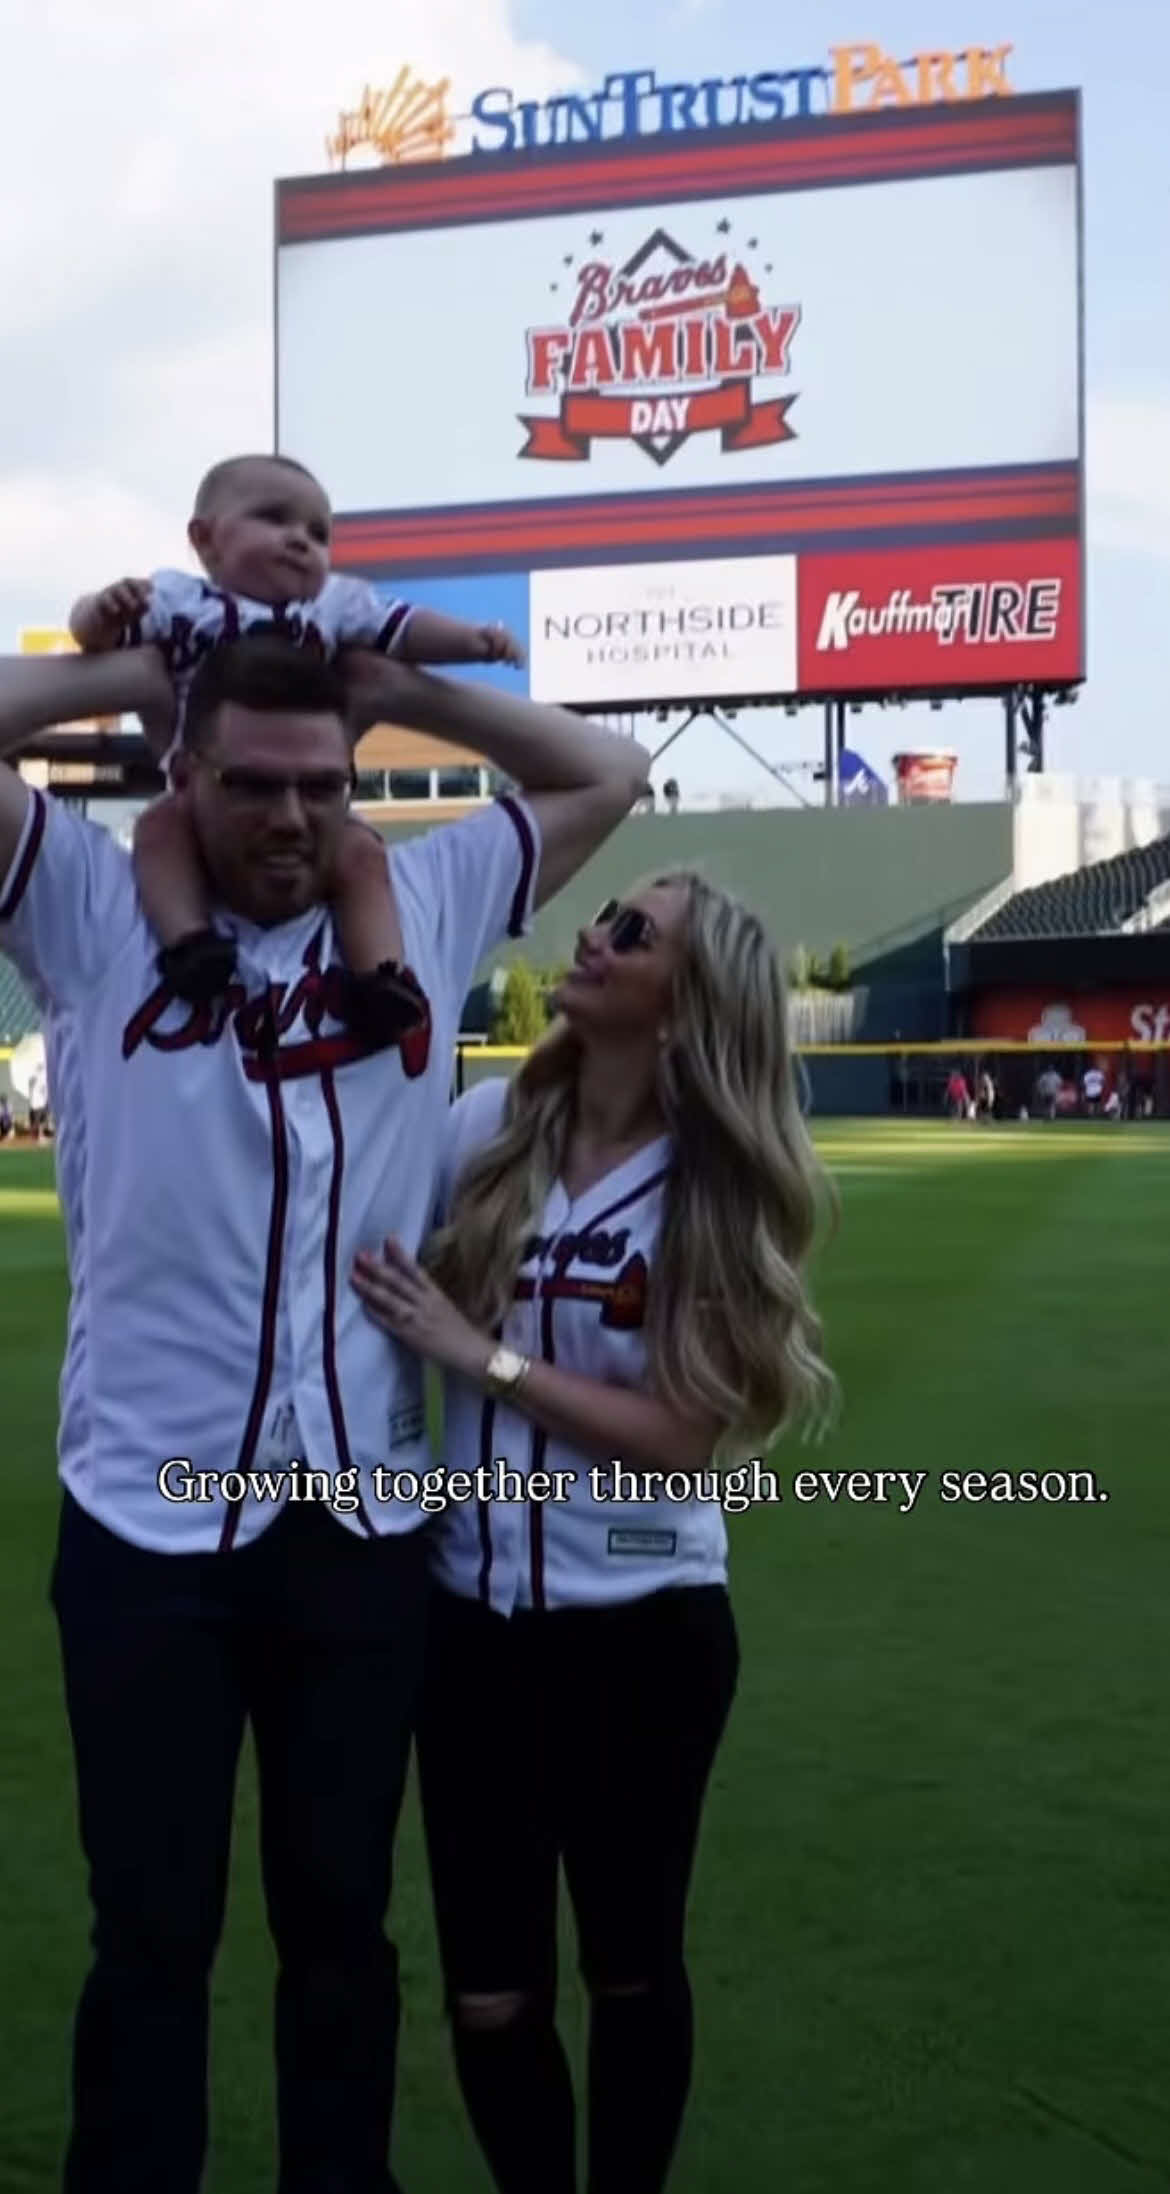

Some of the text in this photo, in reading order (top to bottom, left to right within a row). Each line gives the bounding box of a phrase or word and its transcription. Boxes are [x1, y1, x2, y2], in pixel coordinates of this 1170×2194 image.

[829, 42, 1014, 114] PARK
[570, 252, 727, 327] Braves
[526, 304, 801, 396] FAMILY
[630, 398, 690, 434] DAY
[544, 601, 783, 640] NORTHSIDE
[932, 579, 1061, 645] TIRE
[586, 642, 736, 664] HOSPITAL
